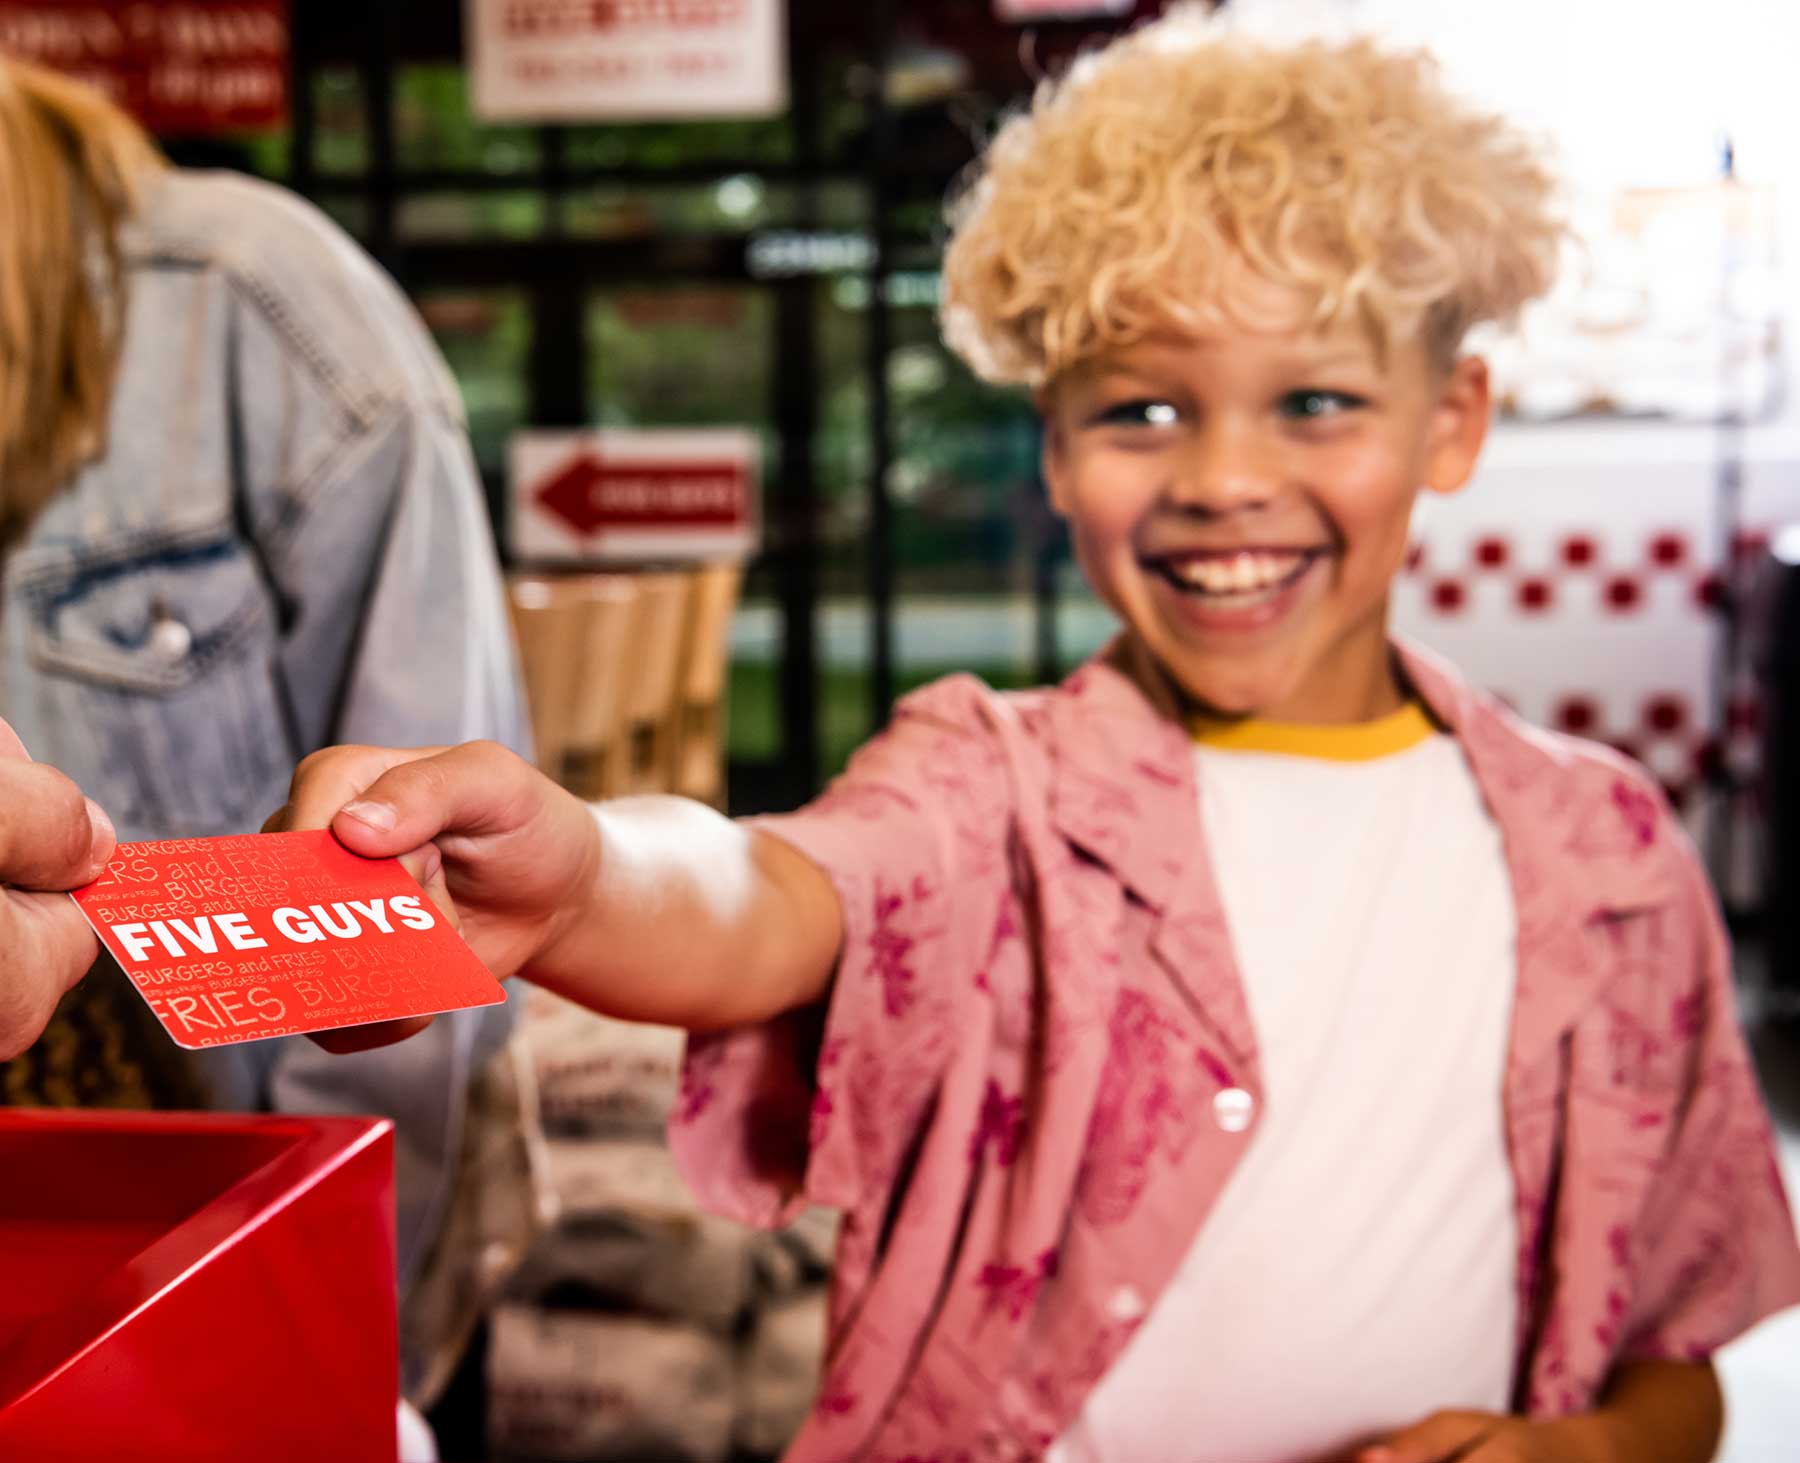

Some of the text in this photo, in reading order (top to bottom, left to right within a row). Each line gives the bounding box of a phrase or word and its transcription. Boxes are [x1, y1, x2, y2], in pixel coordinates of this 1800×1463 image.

[166, 854, 226, 880] and
[164, 874, 289, 900] BURGERS
[97, 900, 197, 923] BURGERS
[201, 896, 236, 913] and
[110, 911, 269, 962] FIVE
[132, 961, 233, 987] BURGERS
[237, 955, 272, 974] and
[270, 949, 327, 969] FRIES
